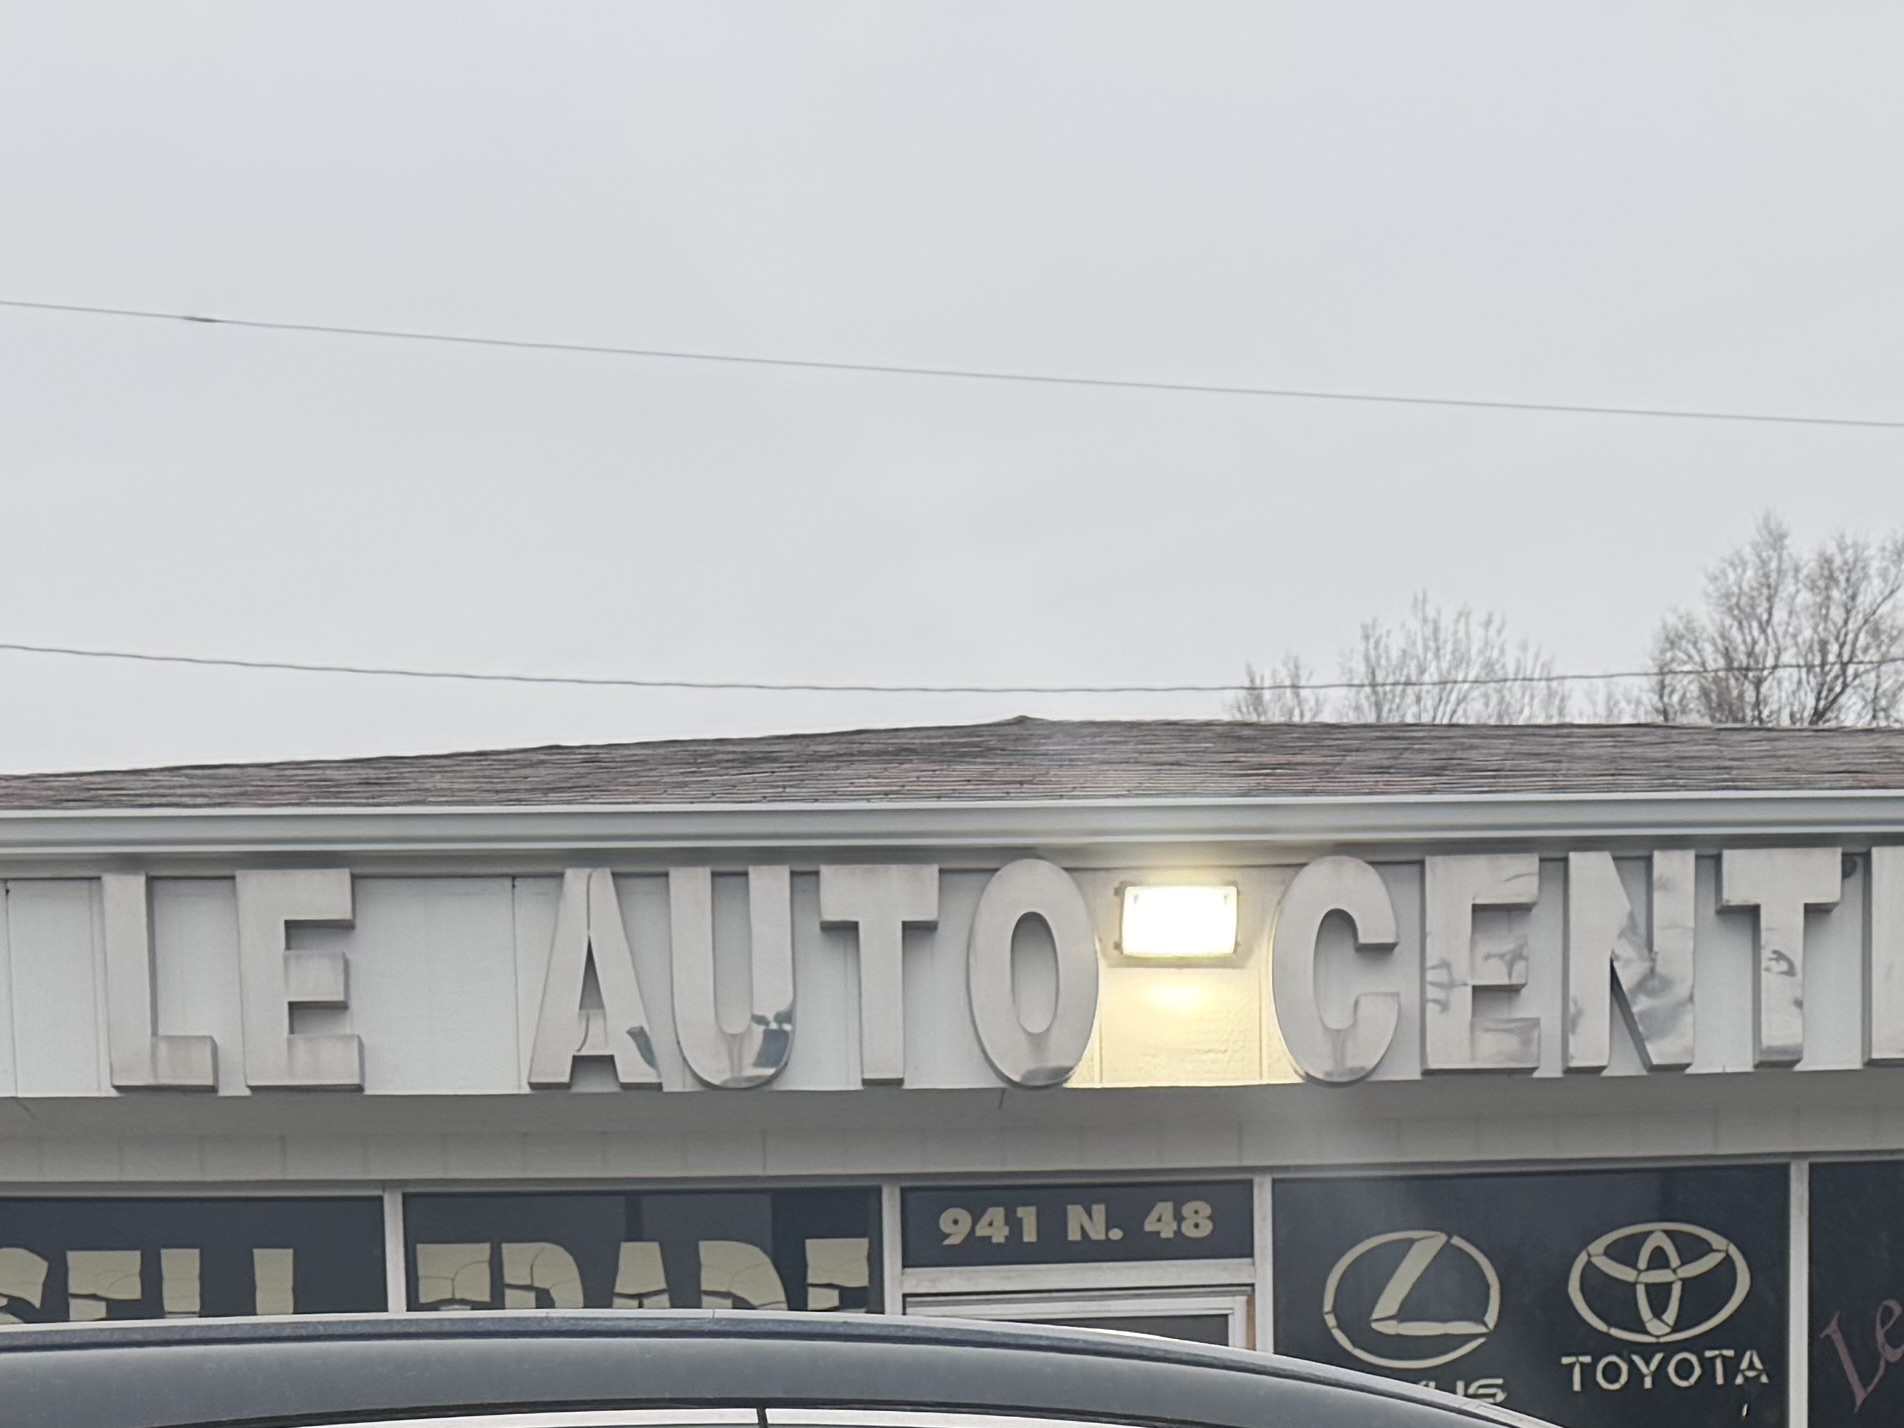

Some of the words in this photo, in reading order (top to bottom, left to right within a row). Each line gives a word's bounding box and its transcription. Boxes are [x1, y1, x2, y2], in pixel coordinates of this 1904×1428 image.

[99, 868, 364, 1095] LE
[529, 857, 1099, 1091] AUTO
[939, 1206, 1038, 1245] 941
[1066, 1203, 1124, 1241] N.
[1143, 1200, 1214, 1239] 48
[1561, 1349, 1769, 1392] TOYOTA
